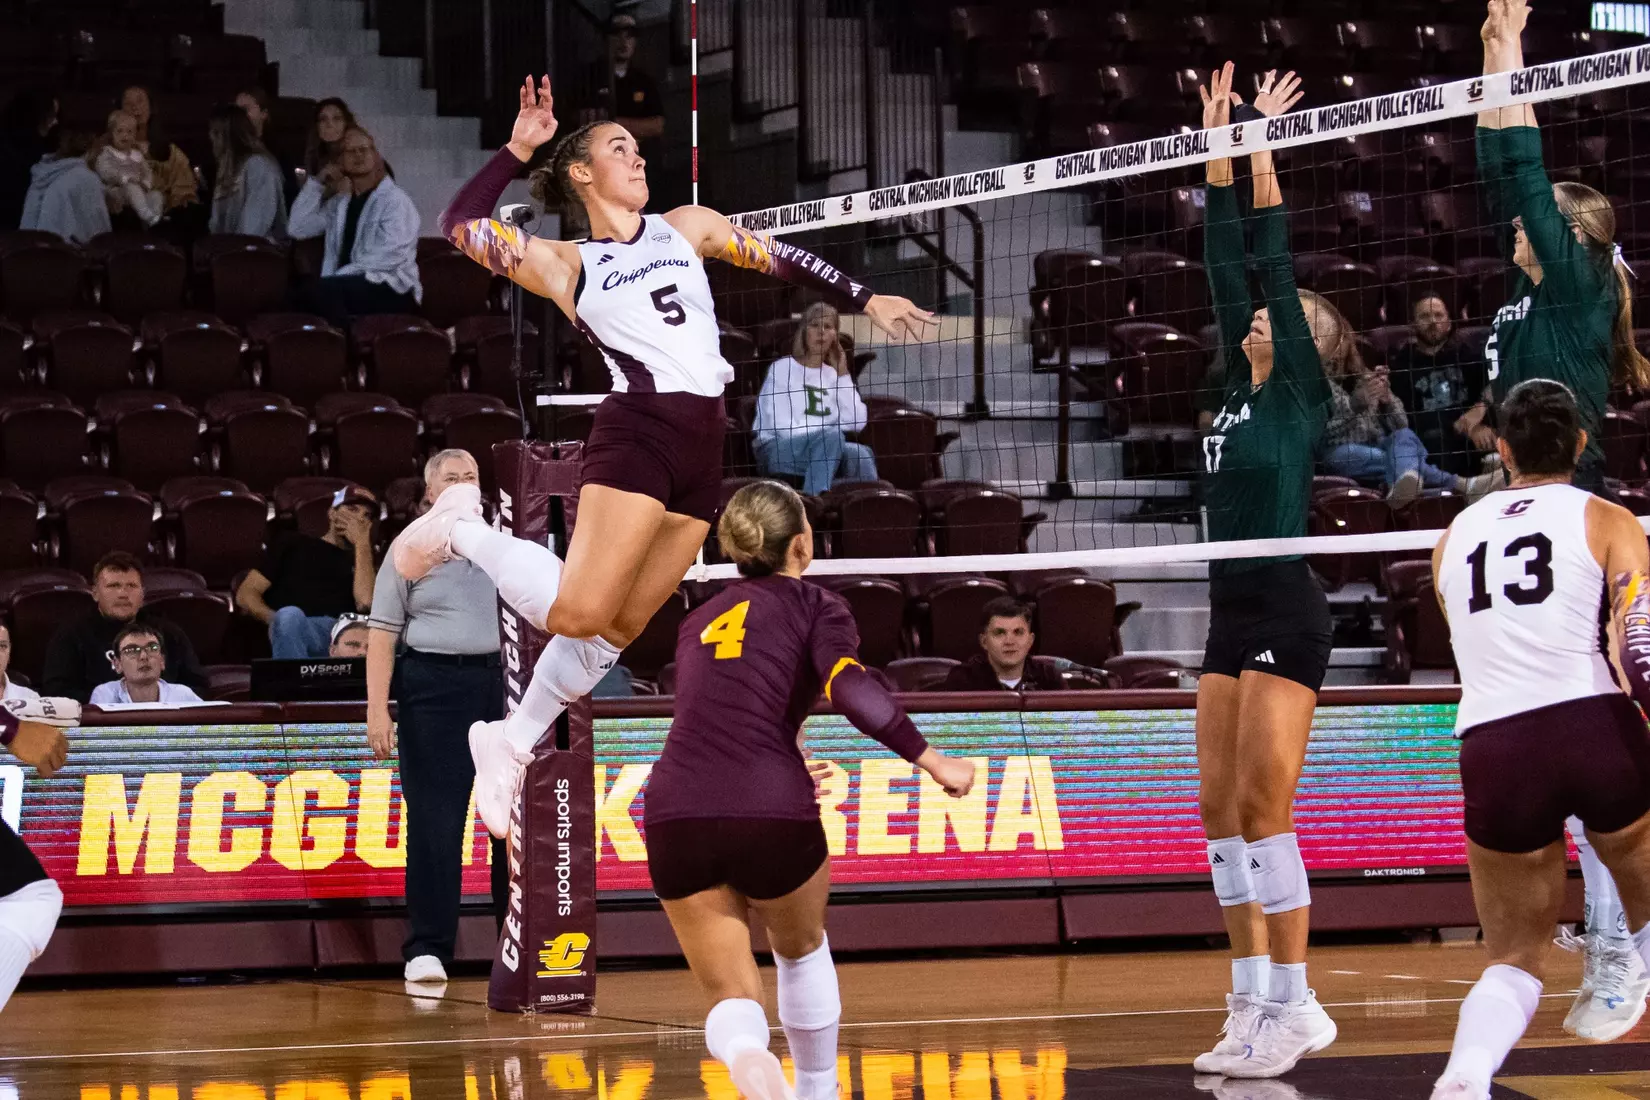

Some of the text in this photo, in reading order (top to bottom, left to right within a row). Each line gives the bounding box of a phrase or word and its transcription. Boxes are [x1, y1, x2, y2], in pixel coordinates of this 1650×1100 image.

[1511, 66, 1564, 96] CENTRAL
[1568, 50, 1632, 86] MICHIGAN
[1267, 87, 1445, 142] CENTRAL MICHIGAN VOLLEYBALL
[1056, 131, 1210, 180] CENTRAL MICHIGAN VOLLEYBALL
[869, 169, 1006, 212] CENTRAL MICHIGAN VOLLEYBALL
[741, 200, 826, 232] MICHIGAN VOLLEYBALL
[602, 259, 689, 291] Chippewas
[767, 235, 842, 285] CHIPPEWAS
[649, 283, 686, 327] 5
[803, 384, 832, 417] E
[1466, 531, 1555, 614] 13
[700, 599, 751, 660] 4
[804, 755, 1065, 856] RENA
[554, 778, 571, 917] sports imports
[1364, 867, 1426, 877] DAKTRONICS
[541, 994, 557, 1002] (800)
